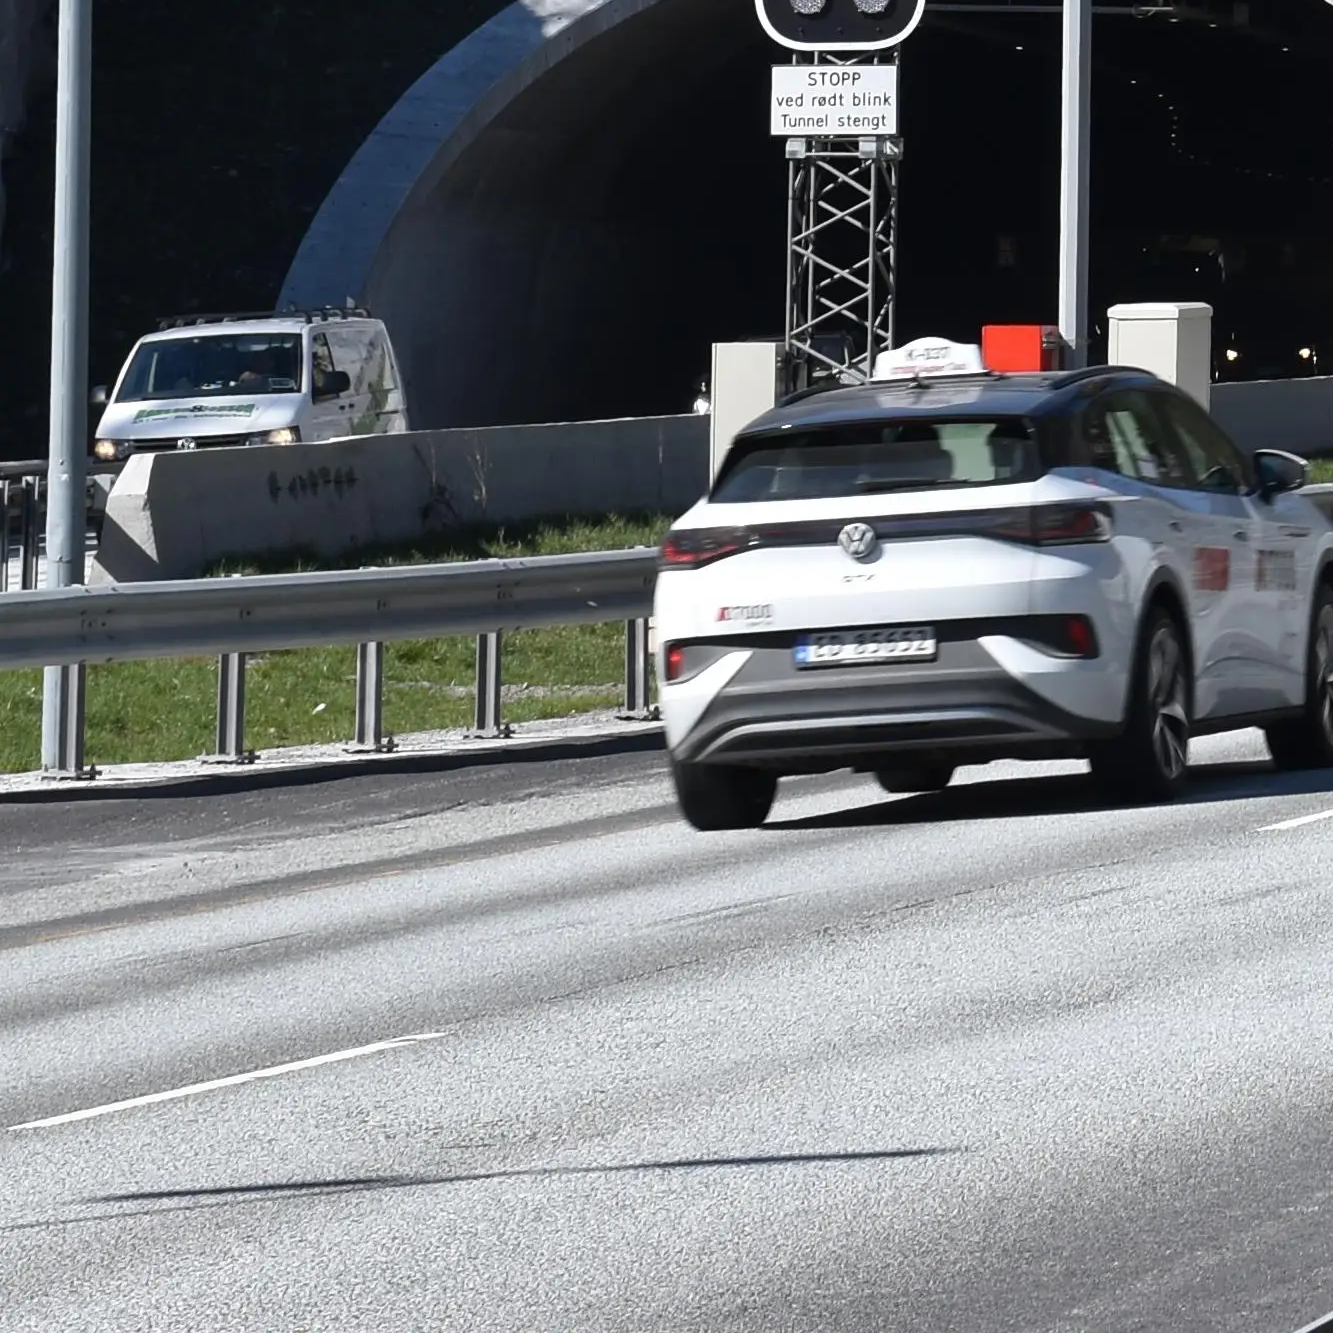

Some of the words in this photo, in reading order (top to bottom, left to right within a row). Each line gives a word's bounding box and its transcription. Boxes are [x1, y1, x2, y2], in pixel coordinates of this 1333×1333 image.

[807, 71, 862, 86] STOPP
[776, 93, 804, 107] ved
[811, 93, 844, 107] rødt
[852, 92, 892, 107] blink
[781, 114, 829, 128] Tunnel
[837, 113, 887, 131] stengt
